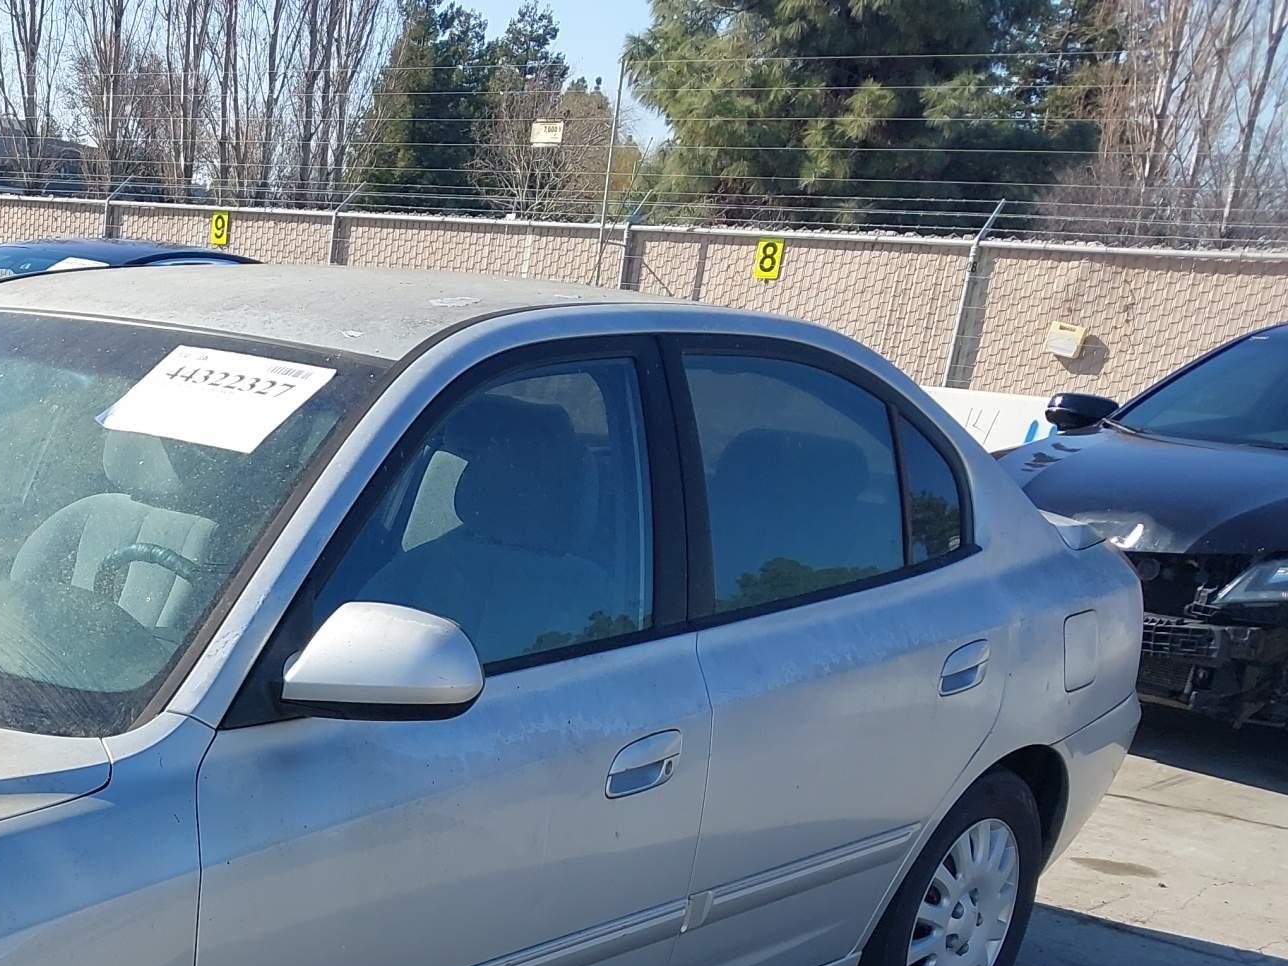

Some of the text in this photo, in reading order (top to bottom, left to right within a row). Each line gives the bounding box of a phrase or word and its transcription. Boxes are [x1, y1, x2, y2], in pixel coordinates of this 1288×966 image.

[214, 215, 225, 239] 9
[759, 242, 778, 272] 8
[166, 366, 296, 398] 44322327
